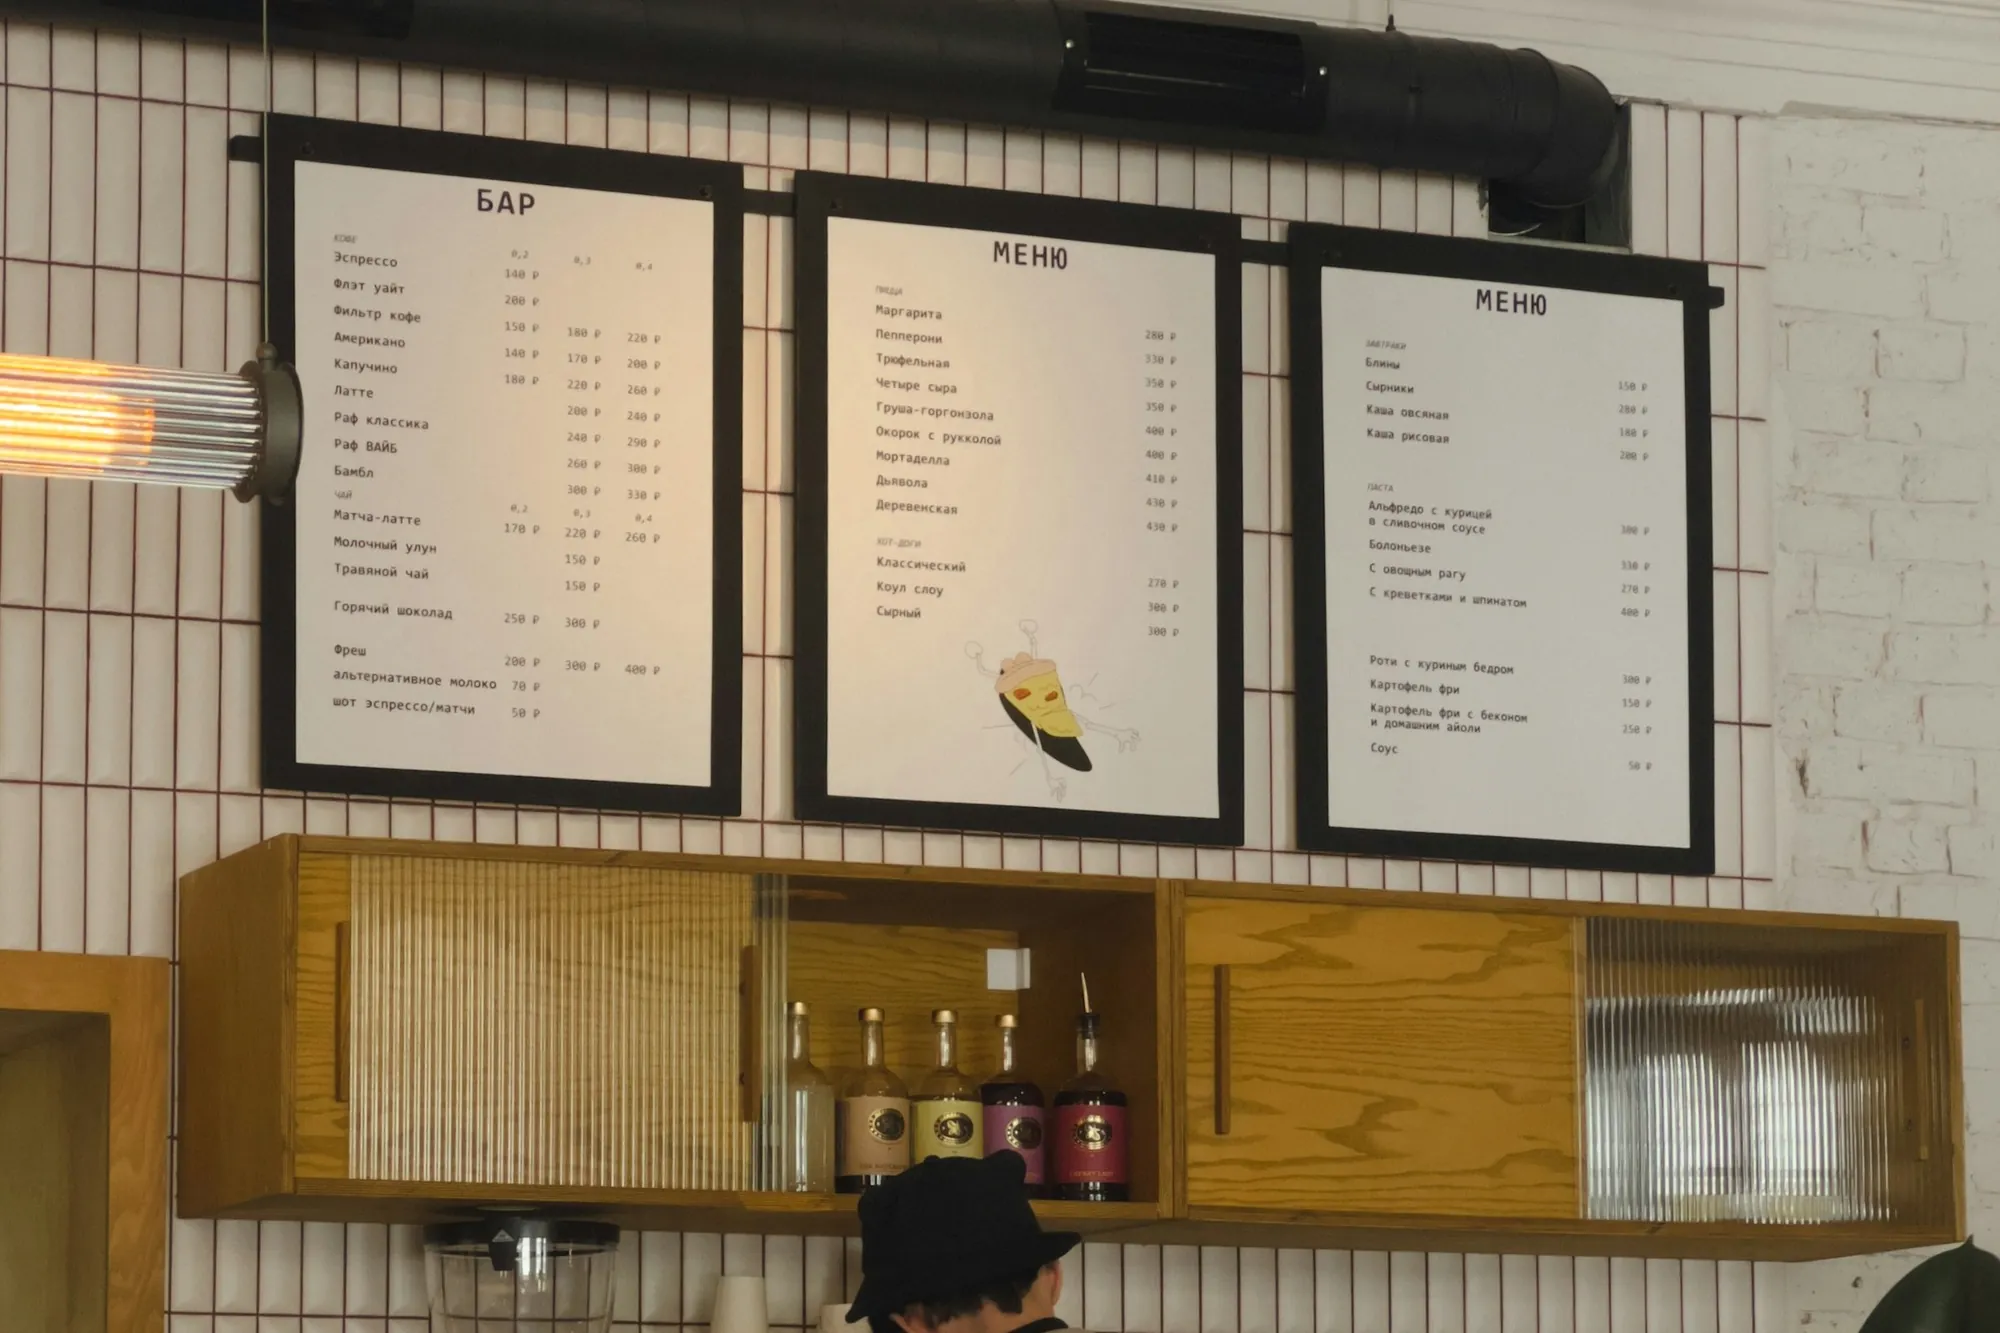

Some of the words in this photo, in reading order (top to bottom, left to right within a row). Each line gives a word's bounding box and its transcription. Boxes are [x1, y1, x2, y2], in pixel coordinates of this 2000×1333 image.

[477, 188, 535, 216] БАР
[334, 251, 398, 268] Эспрессо
[511, 249, 529, 259] 0,2
[993, 240, 1068, 270] МЕНЮ
[636, 262, 652, 271] 0,4
[506, 269, 526, 279] 140
[333, 278, 366, 291] Флэт
[374, 282, 405, 296] уайт
[505, 295, 526, 306] 200
[1476, 288, 1547, 317] МЕНЮ
[333, 304, 382, 322] Фильтр
[390, 311, 421, 324] кофе
[875, 304, 942, 321] Маргарита
[505, 321, 526, 332] 150
[568, 327, 588, 338] 180
[334, 331, 406, 348] Американо
[627, 332, 648, 343] 220
[875, 328, 943, 345] Пепперони
[1145, 330, 1164, 340] 280
[505, 348, 526, 358] 140
[568, 353, 588, 364] 170
[1145, 354, 1164, 364] 330
[334, 358, 398, 374] Капучино
[627, 358, 648, 370] 200
[876, 352, 950, 369] Трюфельная
[1365, 357, 1400, 370] Блины
[505, 374, 526, 385] 180
[567, 379, 588, 390] 220
[1145, 378, 1164, 388] 350
[334, 385, 374, 399] Латте
[628, 384, 648, 396] 260
[876, 377, 920, 393] Четыре
[928, 383, 957, 396] сыра
[1365, 380, 1414, 394] Сырники
[567, 405, 588, 417] 200
[876, 401, 994, 421] Груша-горгонзола
[1145, 402, 1164, 412] 350
[1366, 404, 1394, 416] Каша
[1400, 408, 1450, 420] овсяная
[334, 411, 359, 427] Раф
[366, 416, 429, 430] классика
[627, 411, 648, 422] 240
[876, 425, 920, 440] Окорок
[928, 432, 935, 441] с
[942, 433, 1002, 446] рукколой
[1145, 426, 1164, 436] 400
[1366, 428, 1395, 440] Каша
[1401, 432, 1450, 444] рисовая
[567, 432, 588, 443] 240
[627, 437, 647, 448] 290
[334, 438, 359, 453] Раф
[365, 440, 398, 454] ВАЙБ
[876, 450, 950, 466] Мортаделла
[1145, 450, 1165, 460] 400
[567, 458, 588, 469] 260
[627, 463, 647, 474] 300
[334, 464, 374, 478] Бамбл
[876, 474, 928, 489] Дьявола
[1145, 473, 1165, 484] 410
[567, 484, 588, 496] 300
[1367, 483, 1394, 492] ПАСТА
[627, 489, 647, 500] 330
[510, 504, 528, 513] 0,2
[875, 498, 958, 515] Деревенская
[1146, 497, 1166, 508] 430
[1368, 500, 1424, 515] Альфредо
[1430, 507, 1437, 516] с
[1444, 508, 1492, 520] курицей
[333, 509, 421, 526] Матча-латте
[635, 514, 652, 524] 0,4
[505, 523, 526, 534] 170
[1146, 521, 1166, 532] 430
[1368, 517, 1376, 526] в
[1382, 518, 1445, 531] сливочном
[1452, 523, 1486, 536] соусе
[565, 527, 587, 539] 220
[625, 532, 647, 543] 260
[334, 536, 398, 551] Молочный
[405, 543, 437, 556] улун
[1369, 539, 1431, 554] Болоньезе
[565, 554, 587, 565] 150
[876, 556, 966, 573] Классический
[334, 562, 398, 577] Травяной
[405, 568, 429, 580] чай
[1369, 562, 1376, 574] С
[1383, 566, 1432, 577] овощным
[1438, 569, 1466, 583] рагу
[565, 580, 586, 591] 150
[1148, 578, 1167, 588] 270
[877, 581, 907, 595] Коул
[914, 585, 944, 598] слоу
[1369, 586, 1376, 597] С
[1383, 590, 1453, 602] креветками
[1459, 595, 1466, 603] и
[1472, 596, 1527, 608] шпинатом
[334, 600, 389, 615] Горячий
[397, 607, 453, 621] шоколад
[876, 605, 921, 619] Сырный
[1148, 602, 1167, 613] 300
[504, 613, 526, 624] 250
[565, 617, 586, 629] 300
[1147, 626, 1167, 637] 300
[334, 644, 367, 658] Фреш
[505, 656, 526, 667] 200
[565, 660, 587, 671] 300
[1370, 655, 1398, 667] Роти
[1404, 659, 1410, 668] с
[1418, 660, 1467, 672] куриным
[1473, 661, 1514, 676] бедром
[624, 664, 647, 675] 400
[333, 670, 442, 687] альтернативное
[449, 678, 497, 690] молоко
[512, 680, 527, 692] 70
[1370, 679, 1433, 693] Картофель
[1438, 683, 1460, 696] фри
[332, 697, 357, 707] шот
[365, 699, 475, 715] эспрессо/матчи
[512, 707, 526, 718] 50
[1370, 702, 1433, 717] Картофель
[1438, 707, 1461, 720] фри
[1467, 710, 1474, 719] с
[1480, 709, 1528, 723] беконом
[1370, 718, 1378, 727] и
[1384, 719, 1440, 731] домашним
[1446, 721, 1481, 733] айоли
[1370, 742, 1398, 756] Соус
